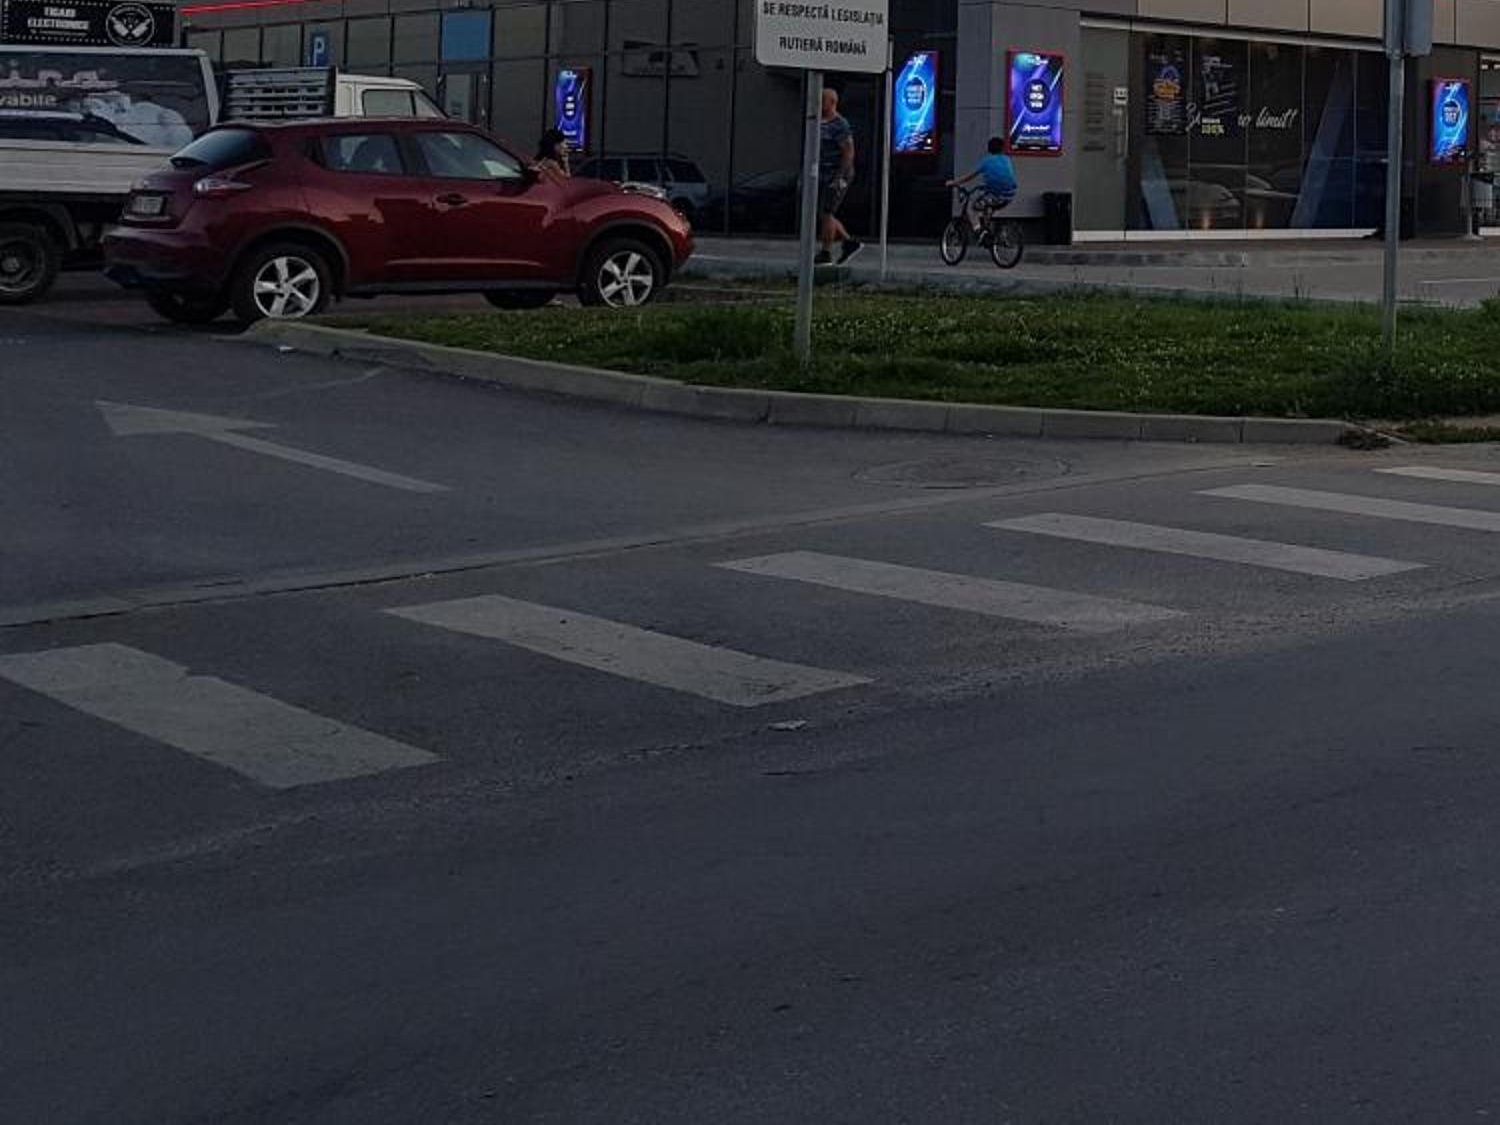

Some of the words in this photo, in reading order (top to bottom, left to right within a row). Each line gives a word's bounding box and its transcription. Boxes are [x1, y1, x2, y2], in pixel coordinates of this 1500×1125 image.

[763, 1, 777, 15] SE
[313, 36, 325, 66] P
[779, 36, 823, 52] RUTIERĂ
[825, 39, 867, 55] ROMÂNĂ
